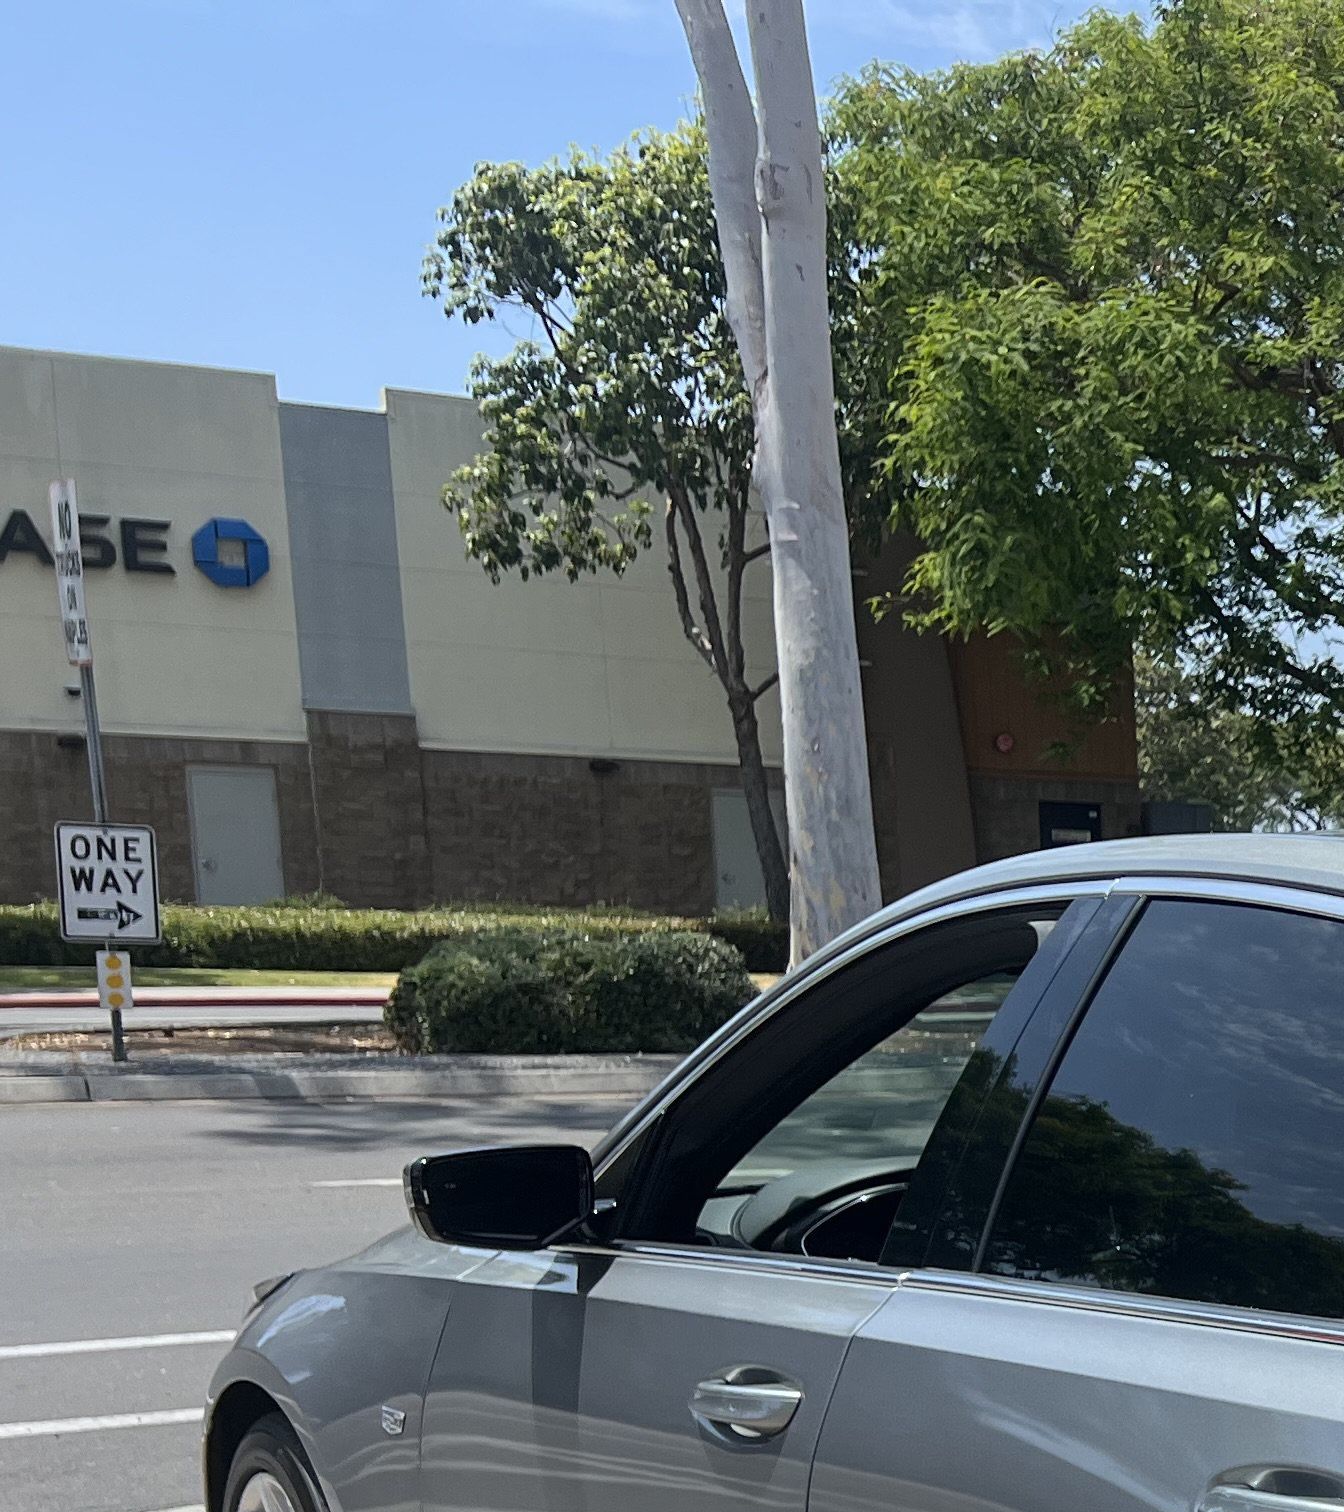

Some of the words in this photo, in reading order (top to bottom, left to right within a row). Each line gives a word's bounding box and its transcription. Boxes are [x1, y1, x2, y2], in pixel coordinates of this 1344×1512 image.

[57, 499, 72, 542] NO
[70, 833, 142, 863] ONE
[69, 865, 144, 895] WAY
